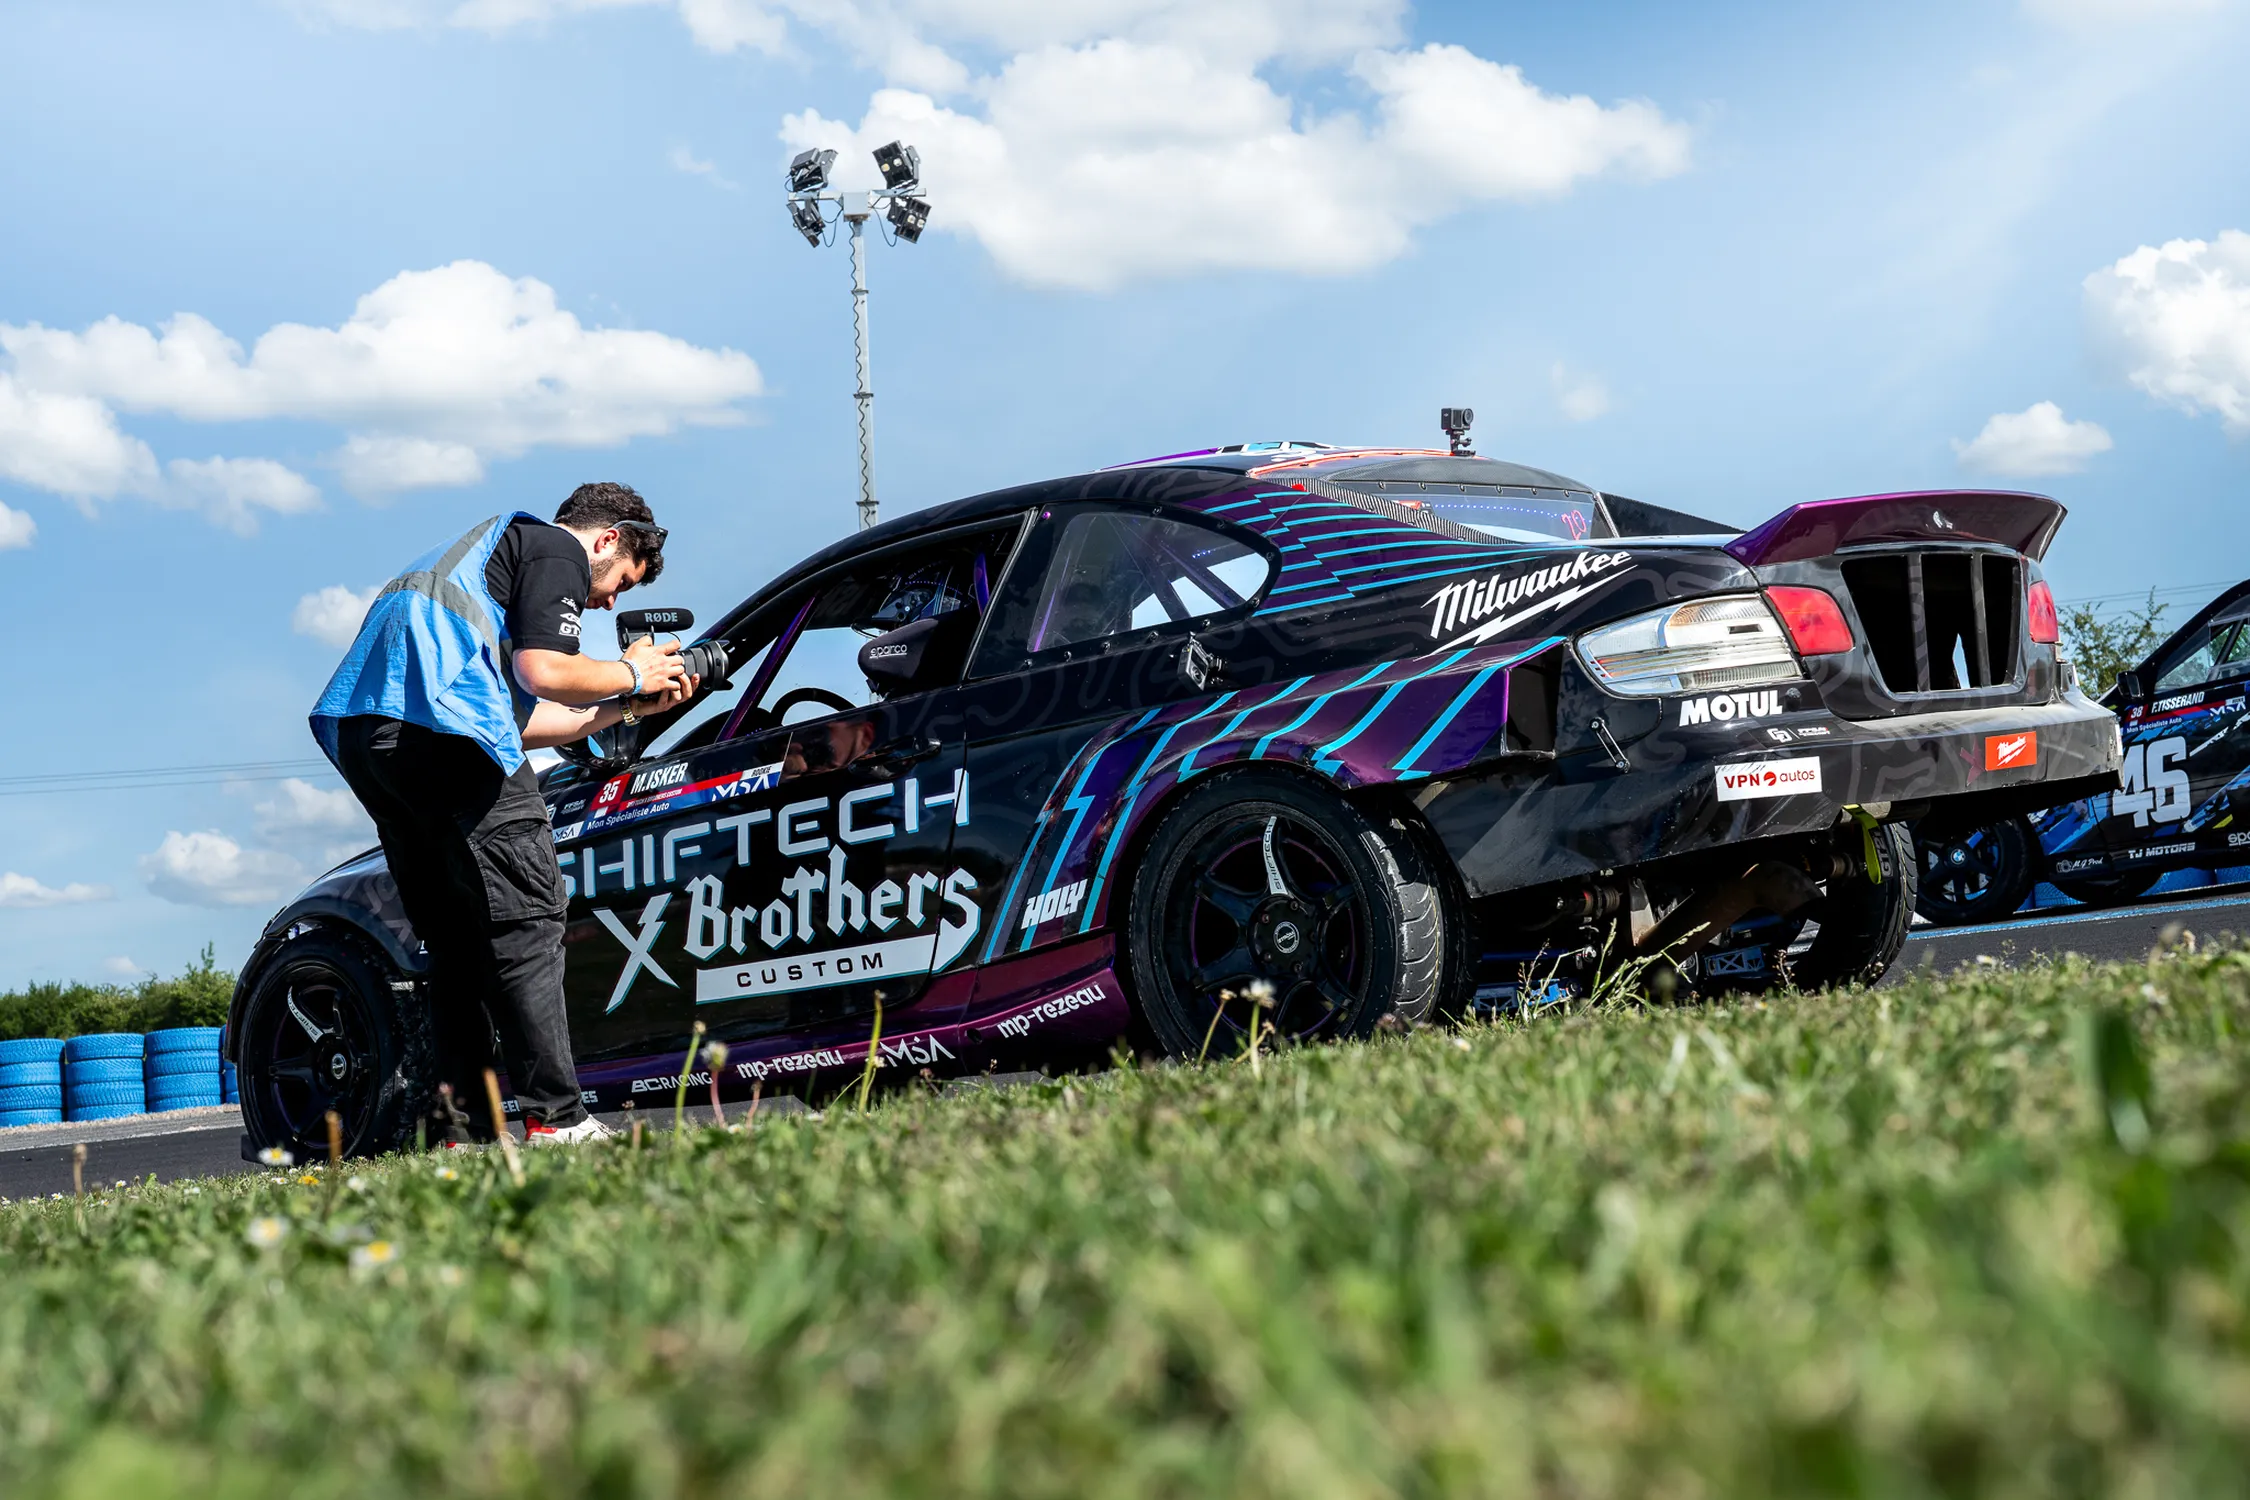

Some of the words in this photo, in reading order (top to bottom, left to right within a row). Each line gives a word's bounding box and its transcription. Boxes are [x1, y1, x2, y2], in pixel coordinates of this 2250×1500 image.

[1420, 551, 1632, 639] Milwaukee
[870, 644, 907, 660] sparco
[1679, 690, 1782, 727] MOTUL
[2131, 706, 2143, 718] 38
[2151, 691, 2205, 714] F.TISSERAND
[599, 780, 621, 803] 35
[630, 762, 688, 794] M.ISKER
[1724, 773, 1760, 789] VPN
[1779, 769, 1815, 783] autos
[2112, 736, 2191, 828] 46
[587, 819, 604, 831] Mon
[606, 808, 649, 826] Spécialiste
[650, 802, 669, 814] Auto
[2128, 849, 2142, 859] TJ
[2145, 842, 2195, 857] MOTORS
[1020, 879, 1088, 930] HOLY
[593, 892, 680, 1014] X
[683, 844, 981, 973] Brothers
[736, 952, 885, 988] CUSTOM
[997, 984, 1106, 1039] mp-rezeau
[736, 1049, 845, 1081] mp-rezeau
